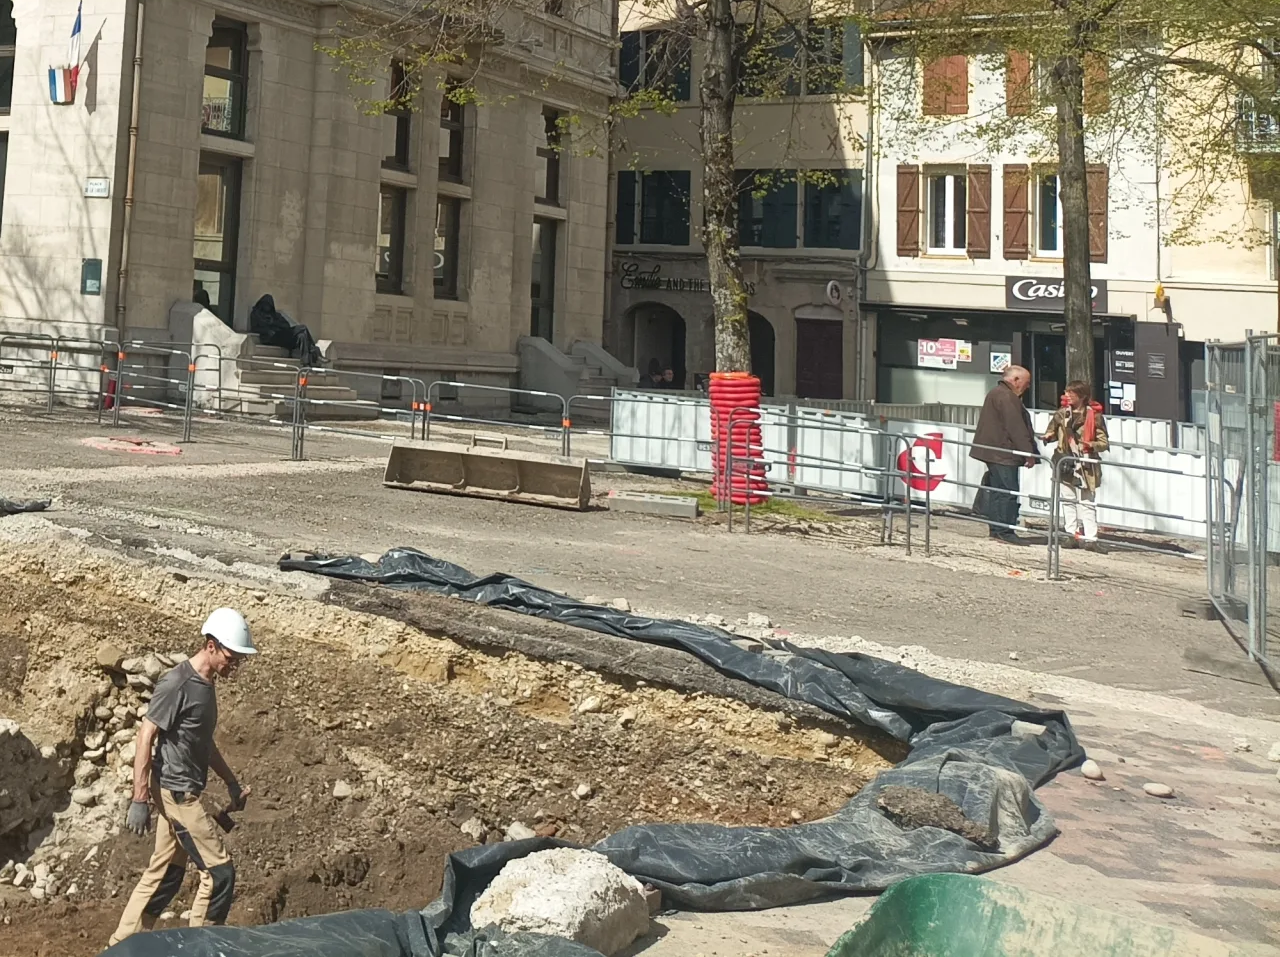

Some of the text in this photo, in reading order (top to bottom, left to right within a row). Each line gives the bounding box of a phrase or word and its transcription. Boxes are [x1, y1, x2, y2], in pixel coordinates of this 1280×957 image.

[620, 262, 661, 290] Emilie
[666, 277, 685, 291] AND
[688, 278, 705, 292] THE
[1012, 279, 1098, 301] Casio
